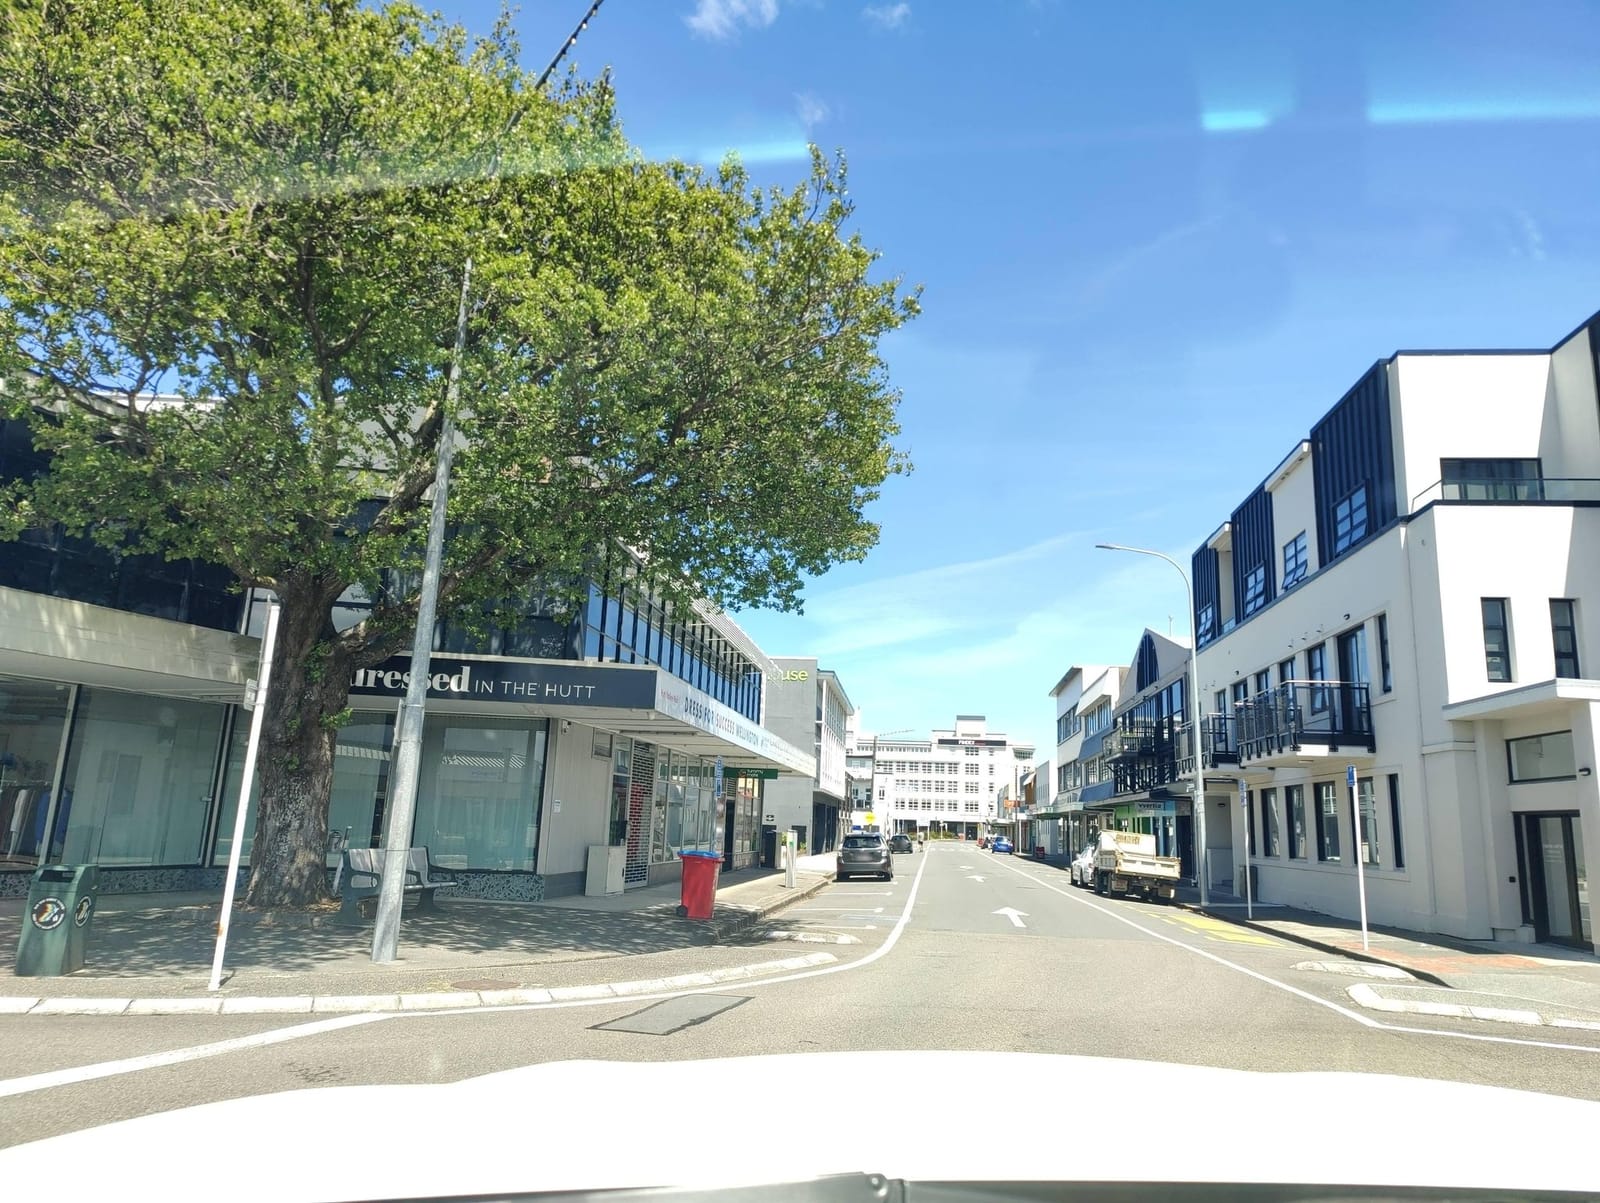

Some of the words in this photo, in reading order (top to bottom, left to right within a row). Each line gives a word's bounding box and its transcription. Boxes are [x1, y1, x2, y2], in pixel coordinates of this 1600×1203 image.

[475, 680, 494, 694] IN
[501, 681, 538, 696] THE
[545, 683, 596, 699] HUTT
[684, 696, 703, 720] DRESS
[716, 712, 735, 735] SUCCESS
